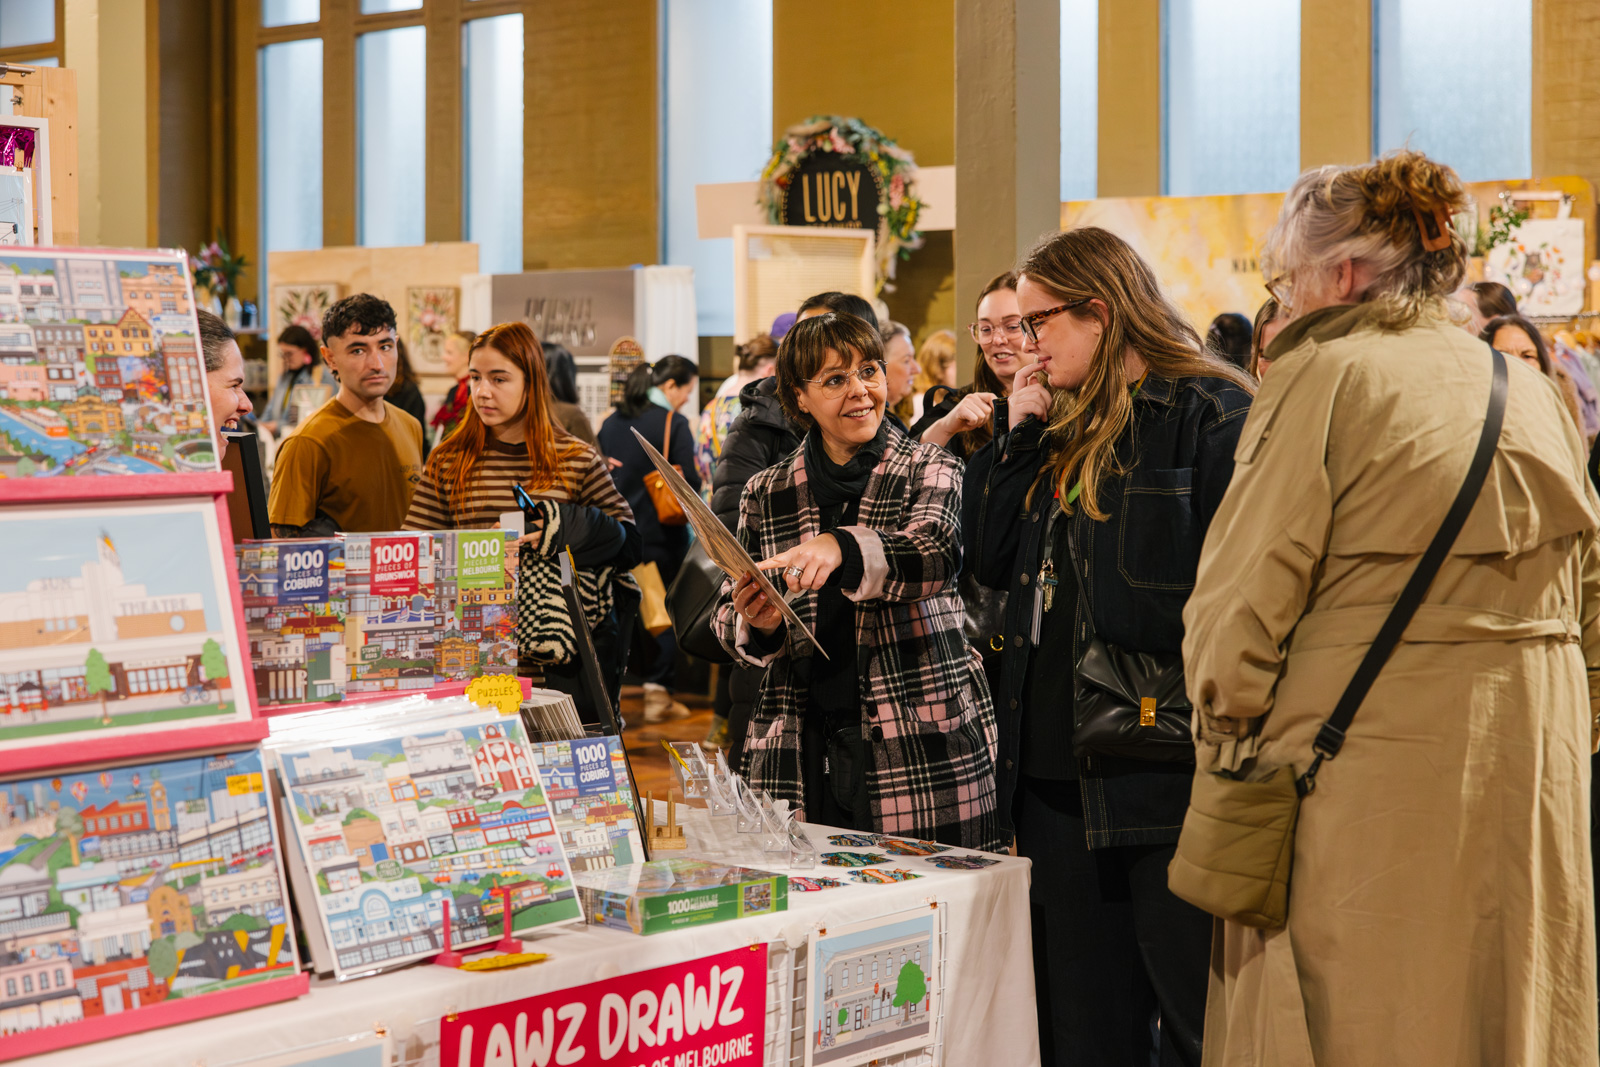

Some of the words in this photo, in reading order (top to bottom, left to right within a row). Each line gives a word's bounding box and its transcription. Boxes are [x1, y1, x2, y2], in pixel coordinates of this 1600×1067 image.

[802, 170, 860, 222] LUCY
[374, 542, 414, 565] 1000
[463, 538, 500, 559] 1000
[283, 549, 324, 572] 1000
[376, 563, 401, 572] PIECES
[464, 558, 488, 567] PIECES
[286, 569, 311, 579] PIECES
[313, 568, 322, 576] OF
[374, 569, 416, 582] BRUNSWICK
[462, 564, 501, 576] MELBOURNE
[283, 576, 324, 591] COBURG
[119, 597, 190, 616] THEATRE
[477, 686, 514, 698] PUZZLES
[575, 743, 606, 765] 1000
[579, 768, 610, 783] COBURG
[580, 763, 599, 772] PIECES
[667, 898, 691, 915] 1000
[598, 964, 744, 1060] DRAWZ
[673, 1033, 753, 1067] MELBOURNE
